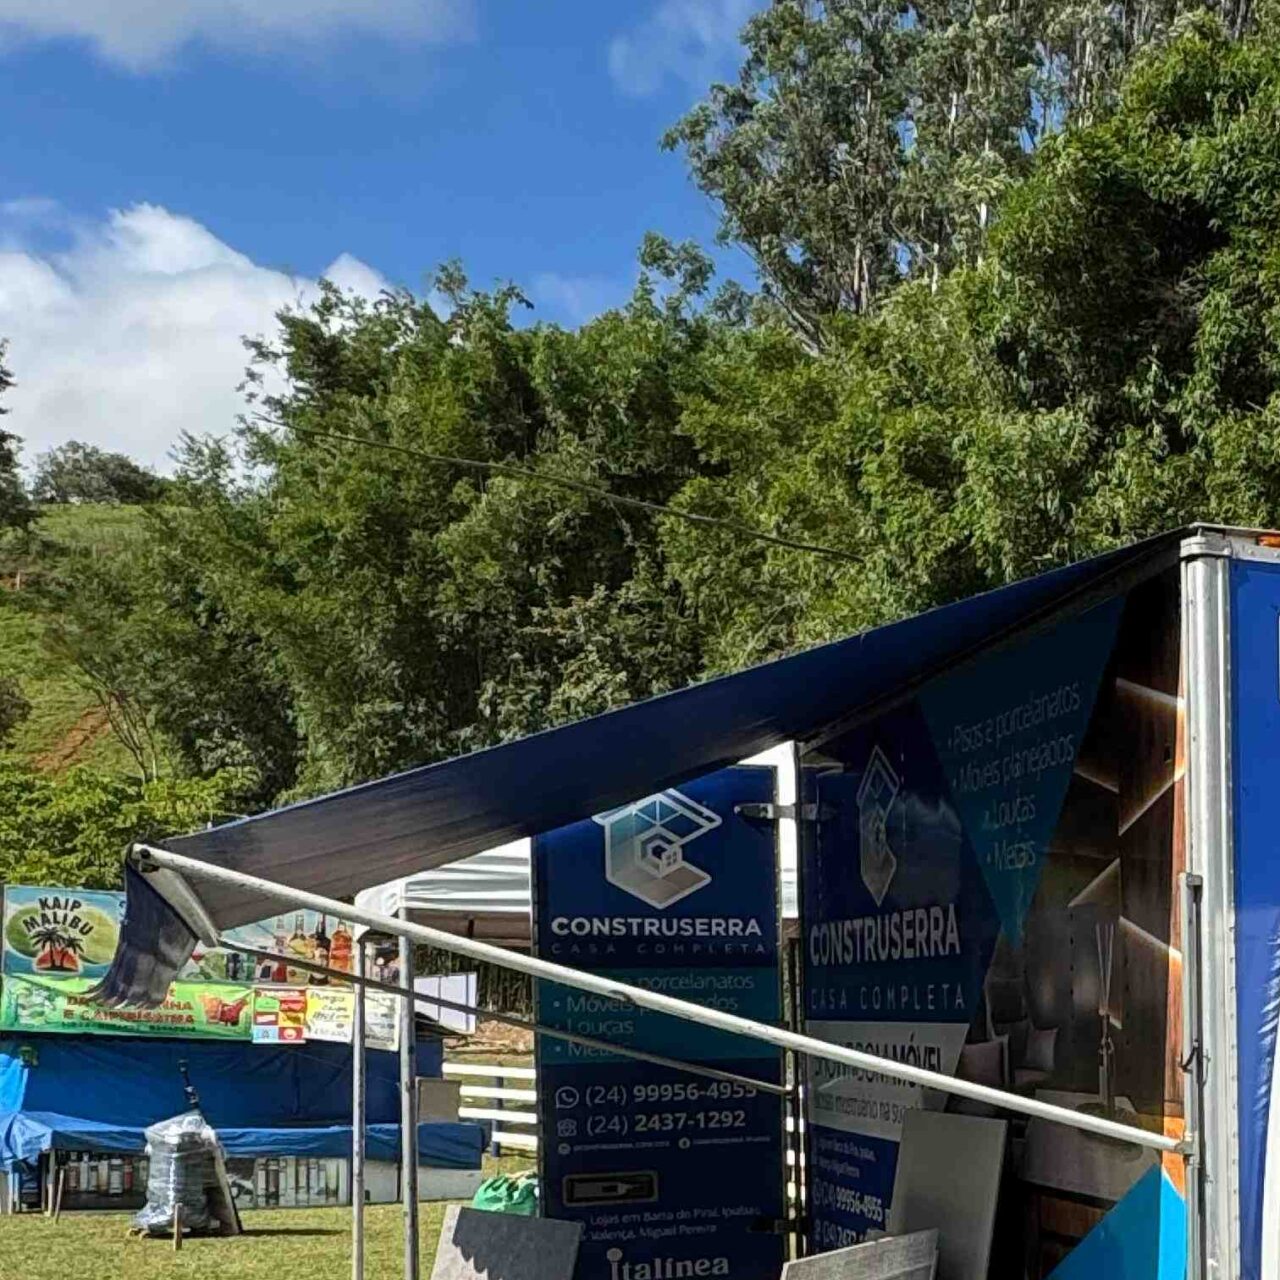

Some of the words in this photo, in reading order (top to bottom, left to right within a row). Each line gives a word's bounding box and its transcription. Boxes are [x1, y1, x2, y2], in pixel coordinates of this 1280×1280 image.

[38, 896, 82, 912] KAIP
[22, 909, 94, 937] MALIBU
[551, 916, 763, 937] CONSTRUSERRA
[810, 903, 961, 967] CONSTRUSERRA
[551, 943, 616, 955] CASA
[636, 943, 765, 955] COMPLETA
[860, 983, 966, 1010] COMPLETA
[585, 1085, 626, 1107] (24)
[586, 1115, 628, 1137] (24)
[634, 1110, 746, 1133] 2437-1292
